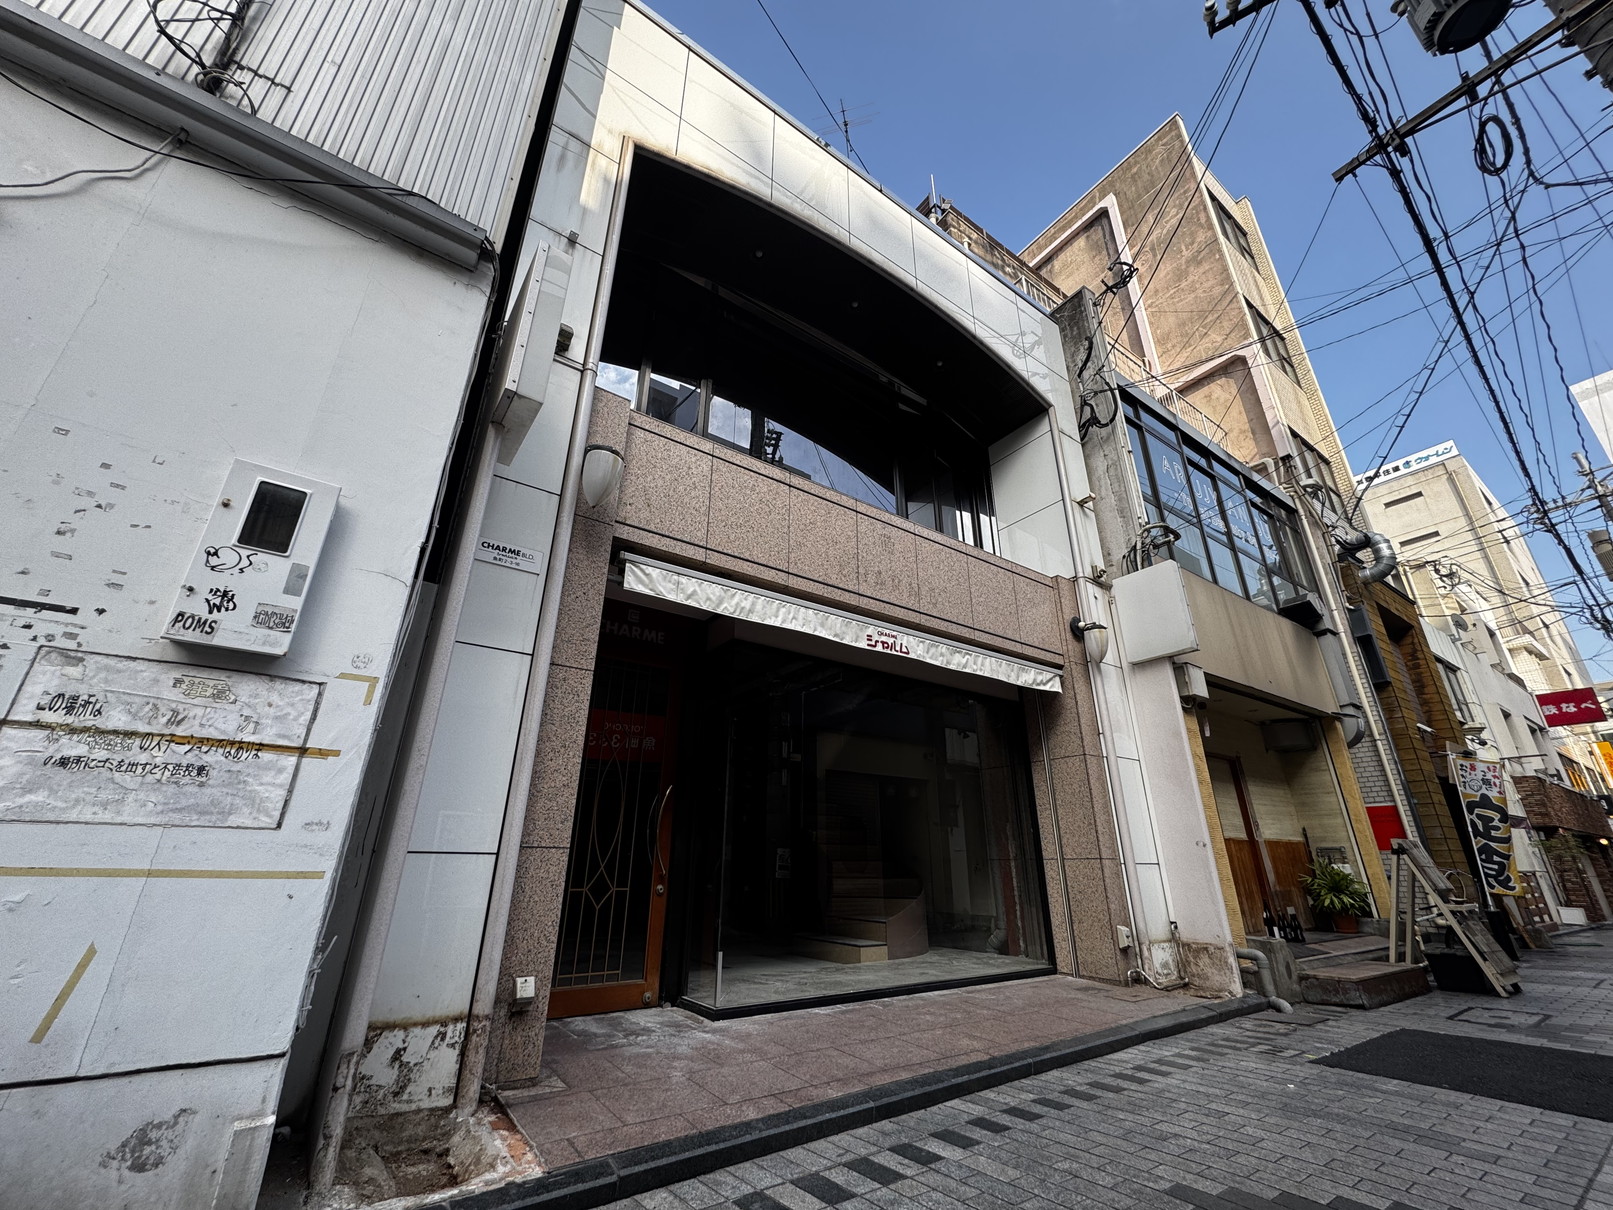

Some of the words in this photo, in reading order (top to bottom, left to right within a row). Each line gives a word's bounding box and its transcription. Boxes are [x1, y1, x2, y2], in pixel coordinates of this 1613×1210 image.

[481, 541, 521, 557] CHARME
[172, 612, 218, 635] POMS
[1465, 793, 1517, 892] 定食
